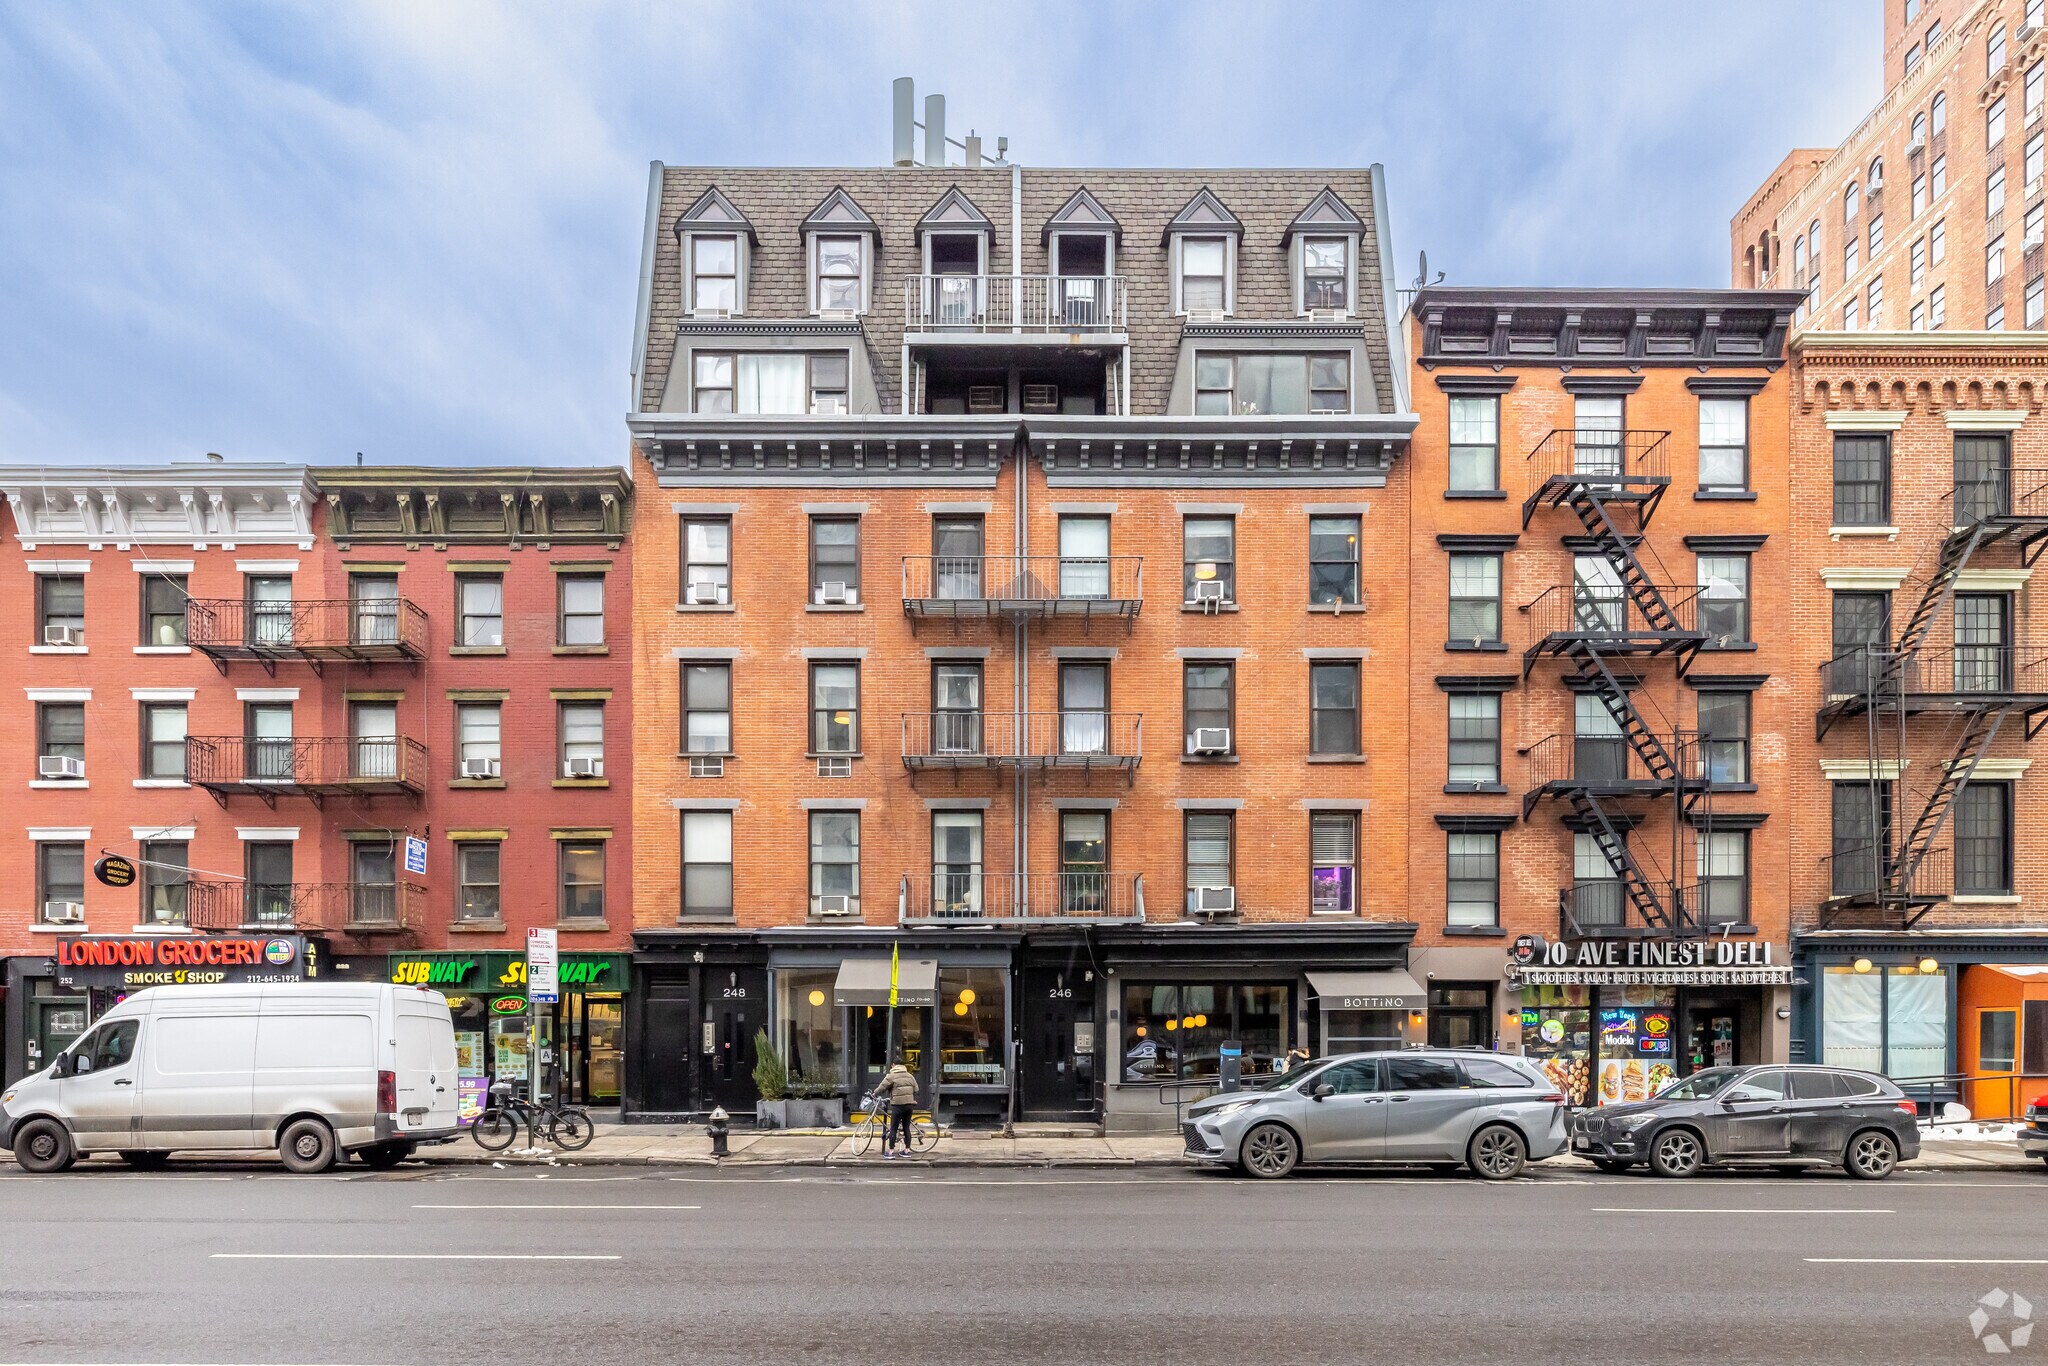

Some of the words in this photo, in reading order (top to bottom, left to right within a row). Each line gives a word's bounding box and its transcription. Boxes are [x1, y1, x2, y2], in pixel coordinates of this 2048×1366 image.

[106, 868, 129, 877] GROCERY
[531, 929, 536, 937] 3
[58, 940, 154, 966] LONDON
[157, 939, 267, 965] GROCERY
[1543, 941, 1568, 965] 10
[1577, 941, 1620, 965] AVE
[1628, 941, 1707, 965] FINEST
[1717, 941, 1771, 965] DELI
[308, 943, 317, 977] ATM
[392, 961, 474, 983] SUBWAY
[499, 961, 611, 984] SWAY
[124, 972, 172, 983] SMOKE
[187, 972, 224, 983] SHOP
[247, 975, 300, 983] 212-645-1934
[1531, 974, 1577, 983] SMOOTHIES
[1583, 974, 1608, 983] SALAD
[1613, 974, 1640, 983] FRUITS
[1647, 974, 1694, 983] VEGETABLES
[1700, 974, 1725, 983] SOUPS
[1731, 974, 1783, 983] SANDWICHES
[723, 988, 746, 997] 248
[1049, 988, 1072, 998] 246
[495, 1000, 523, 1011] OPEN
[1522, 1013, 1539, 1023] TM
[1602, 1011, 1617, 1021] New
[1619, 1009, 1637, 1021] York
[1605, 1035, 1634, 1046] Modelo
[542, 1050, 550, 1060] A
[1274, 1059, 1283, 1069] A
